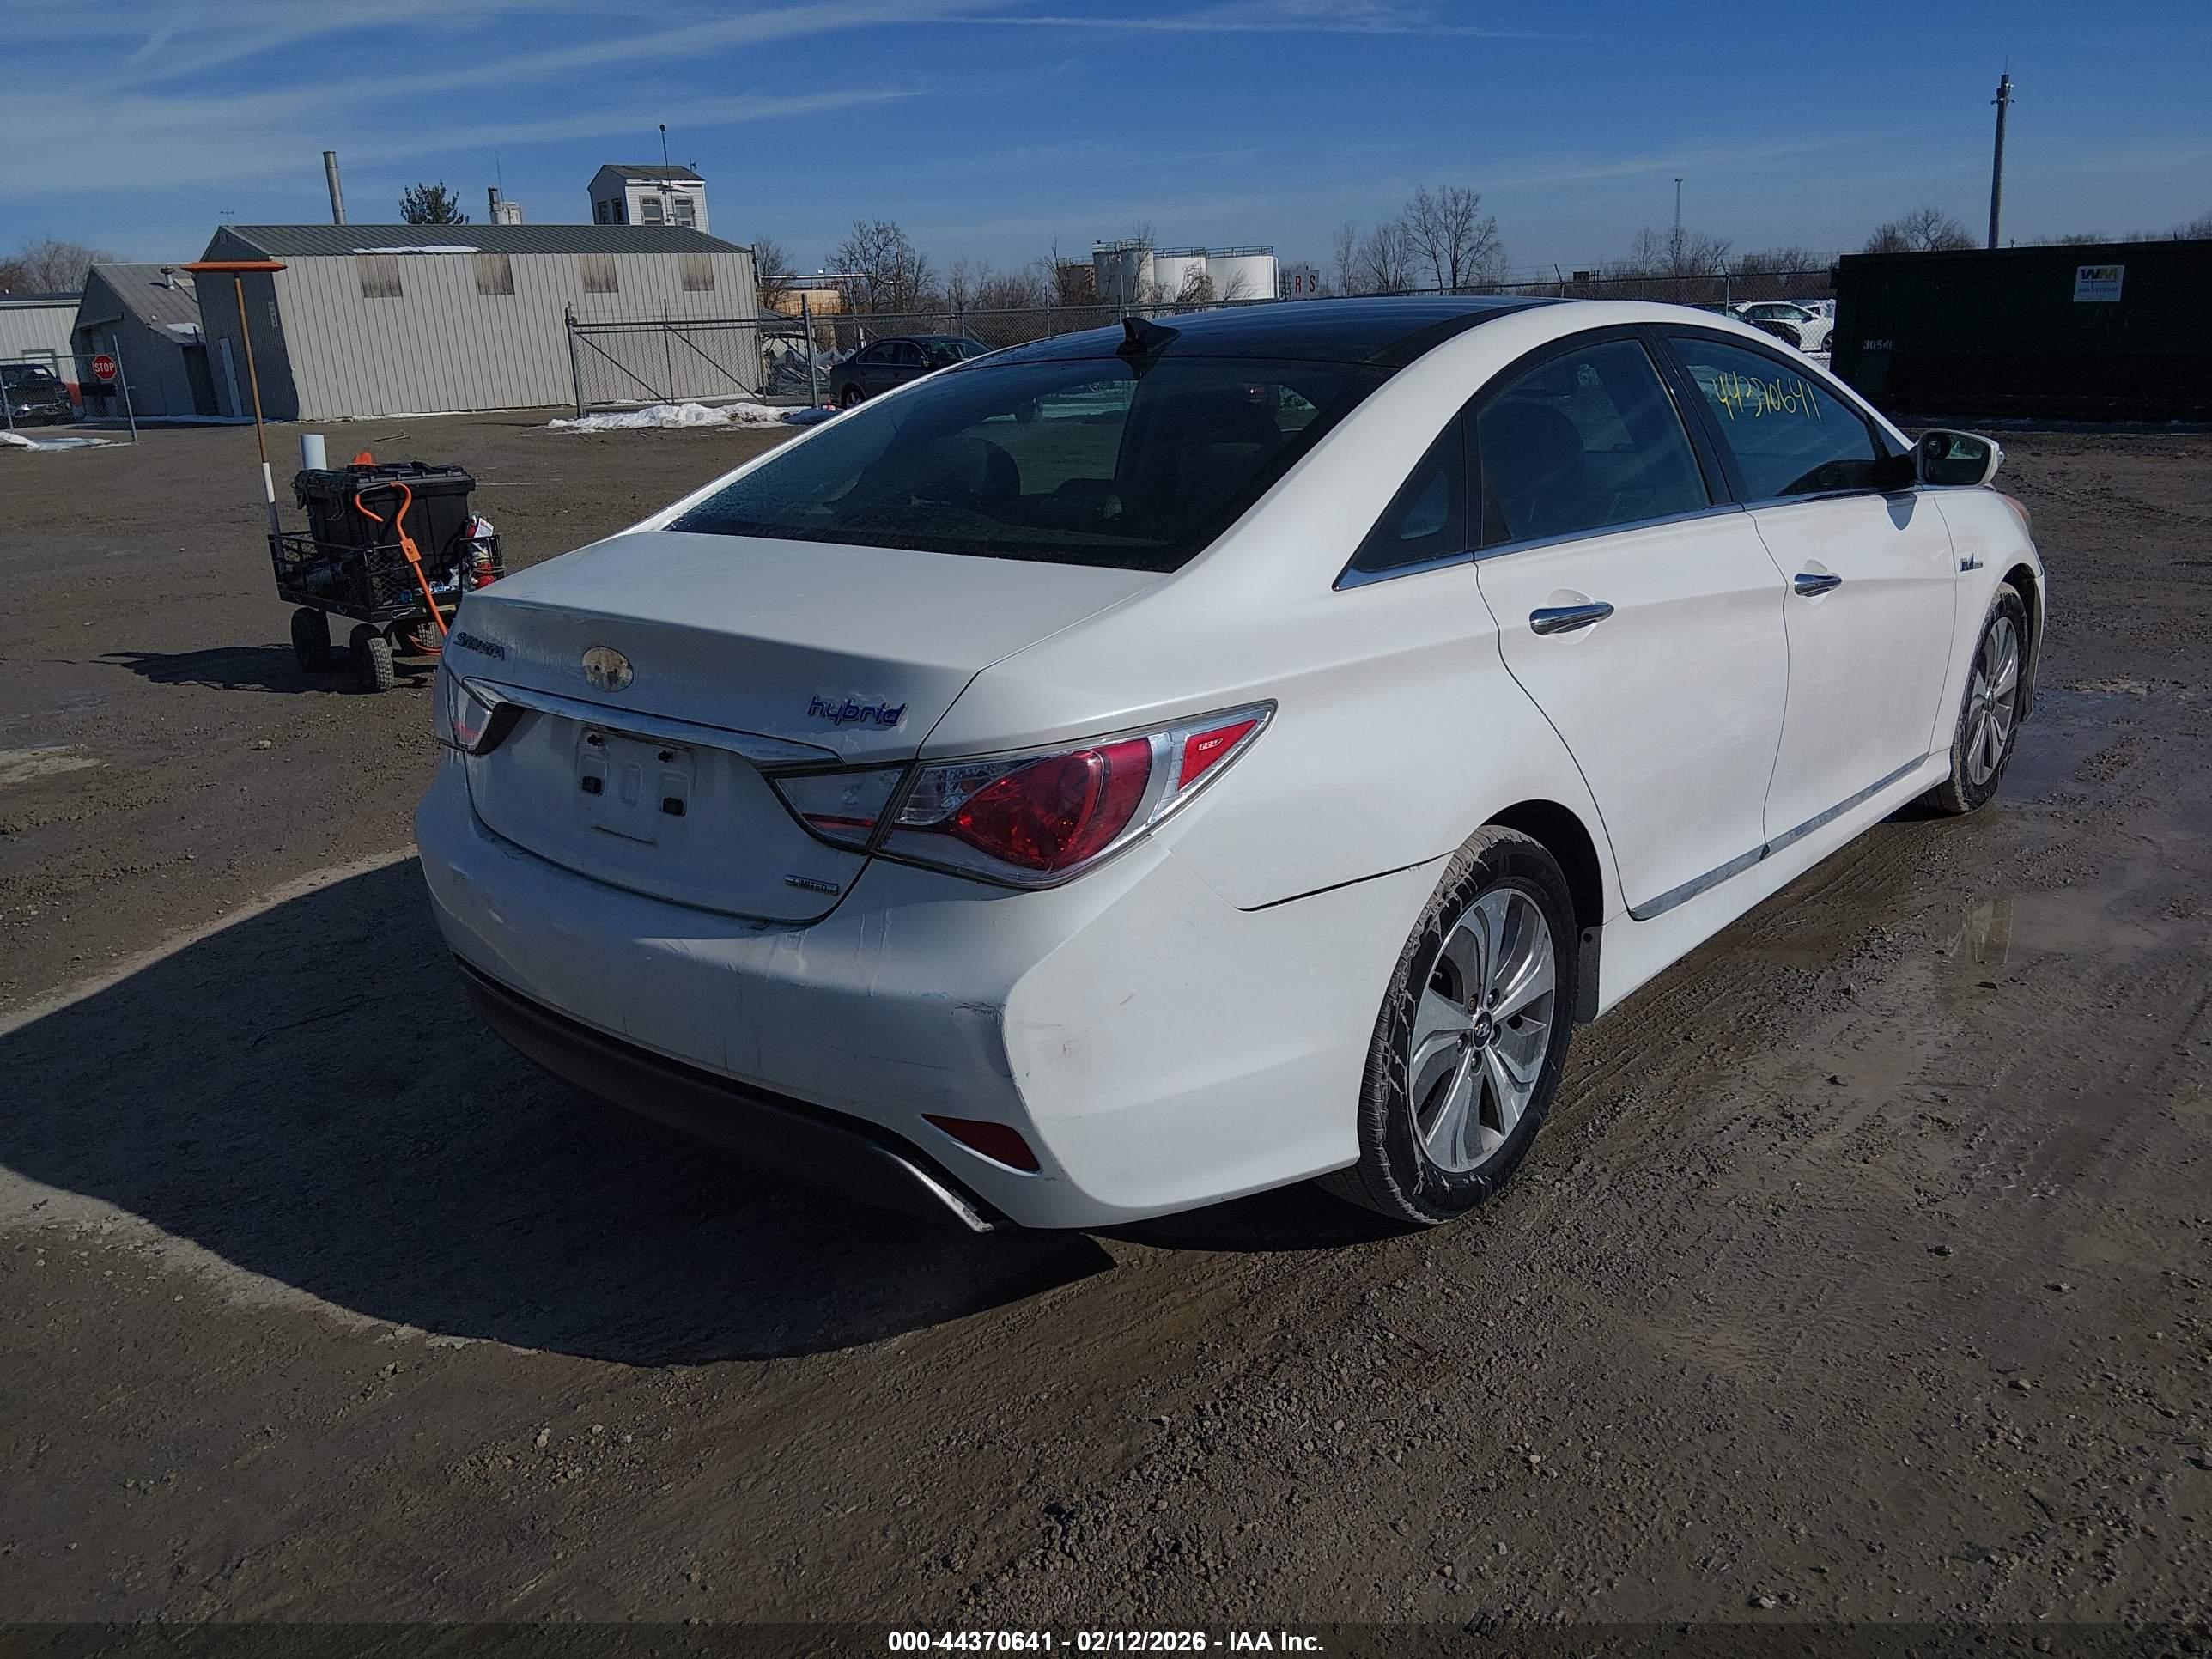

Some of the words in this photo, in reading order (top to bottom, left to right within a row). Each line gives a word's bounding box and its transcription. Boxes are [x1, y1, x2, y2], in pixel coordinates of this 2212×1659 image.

[94, 362, 114, 372] STOP
[807, 694, 908, 726] hybrid
[793, 878, 829, 892] LIMITED
